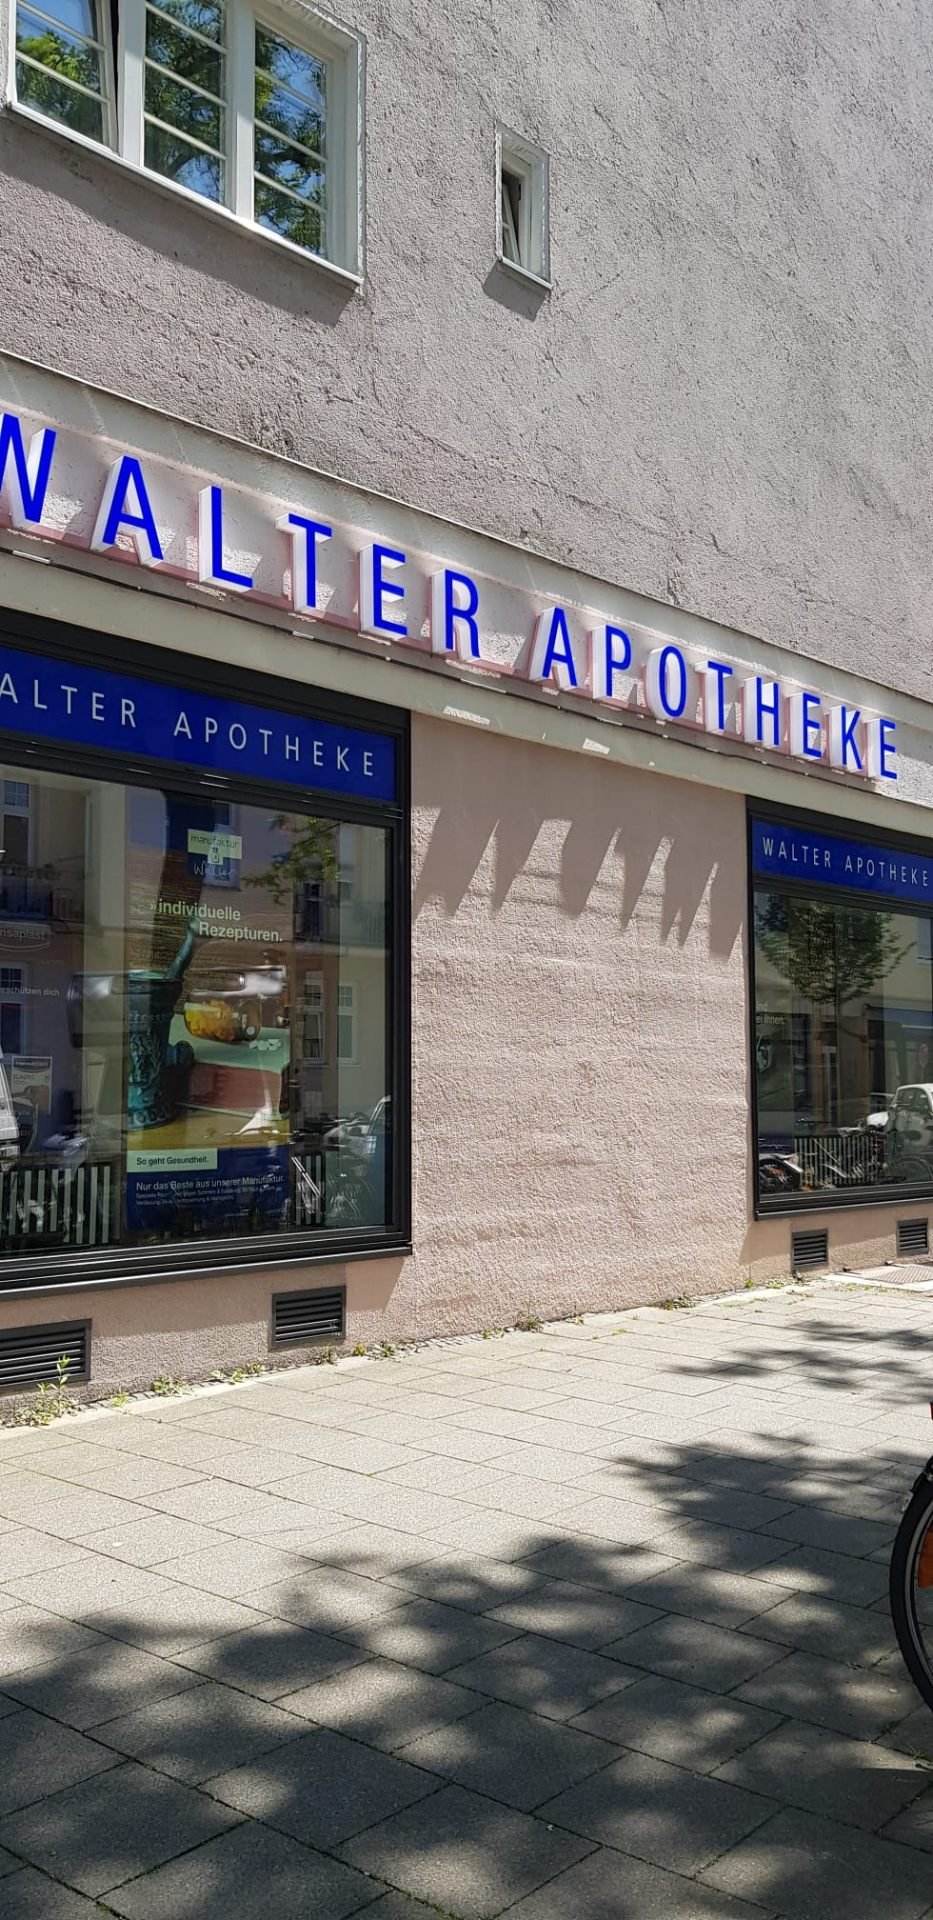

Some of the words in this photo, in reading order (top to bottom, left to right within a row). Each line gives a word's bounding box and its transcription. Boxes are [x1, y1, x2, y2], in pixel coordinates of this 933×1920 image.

[540, 606, 898, 780] APOTHEKE
[173, 711, 375, 777] APOTHEKE
[190, 833, 240, 849] manufaktur
[762, 836, 831, 868] WALTER
[844, 855, 928, 887] APOTHEKE
[199, 921, 283, 942] Rezepturen.
[136, 1157, 147, 1166] So
[148, 1156, 165, 1167] geht
[166, 1155, 209, 1165] Gesundheit.
[136, 1181, 152, 1191] Nur
[153, 1180, 169, 1190] das
[170, 1180, 194, 1190] Beste
[195, 1180, 210, 1189] aus
[211, 1178, 241, 1188] unserer
